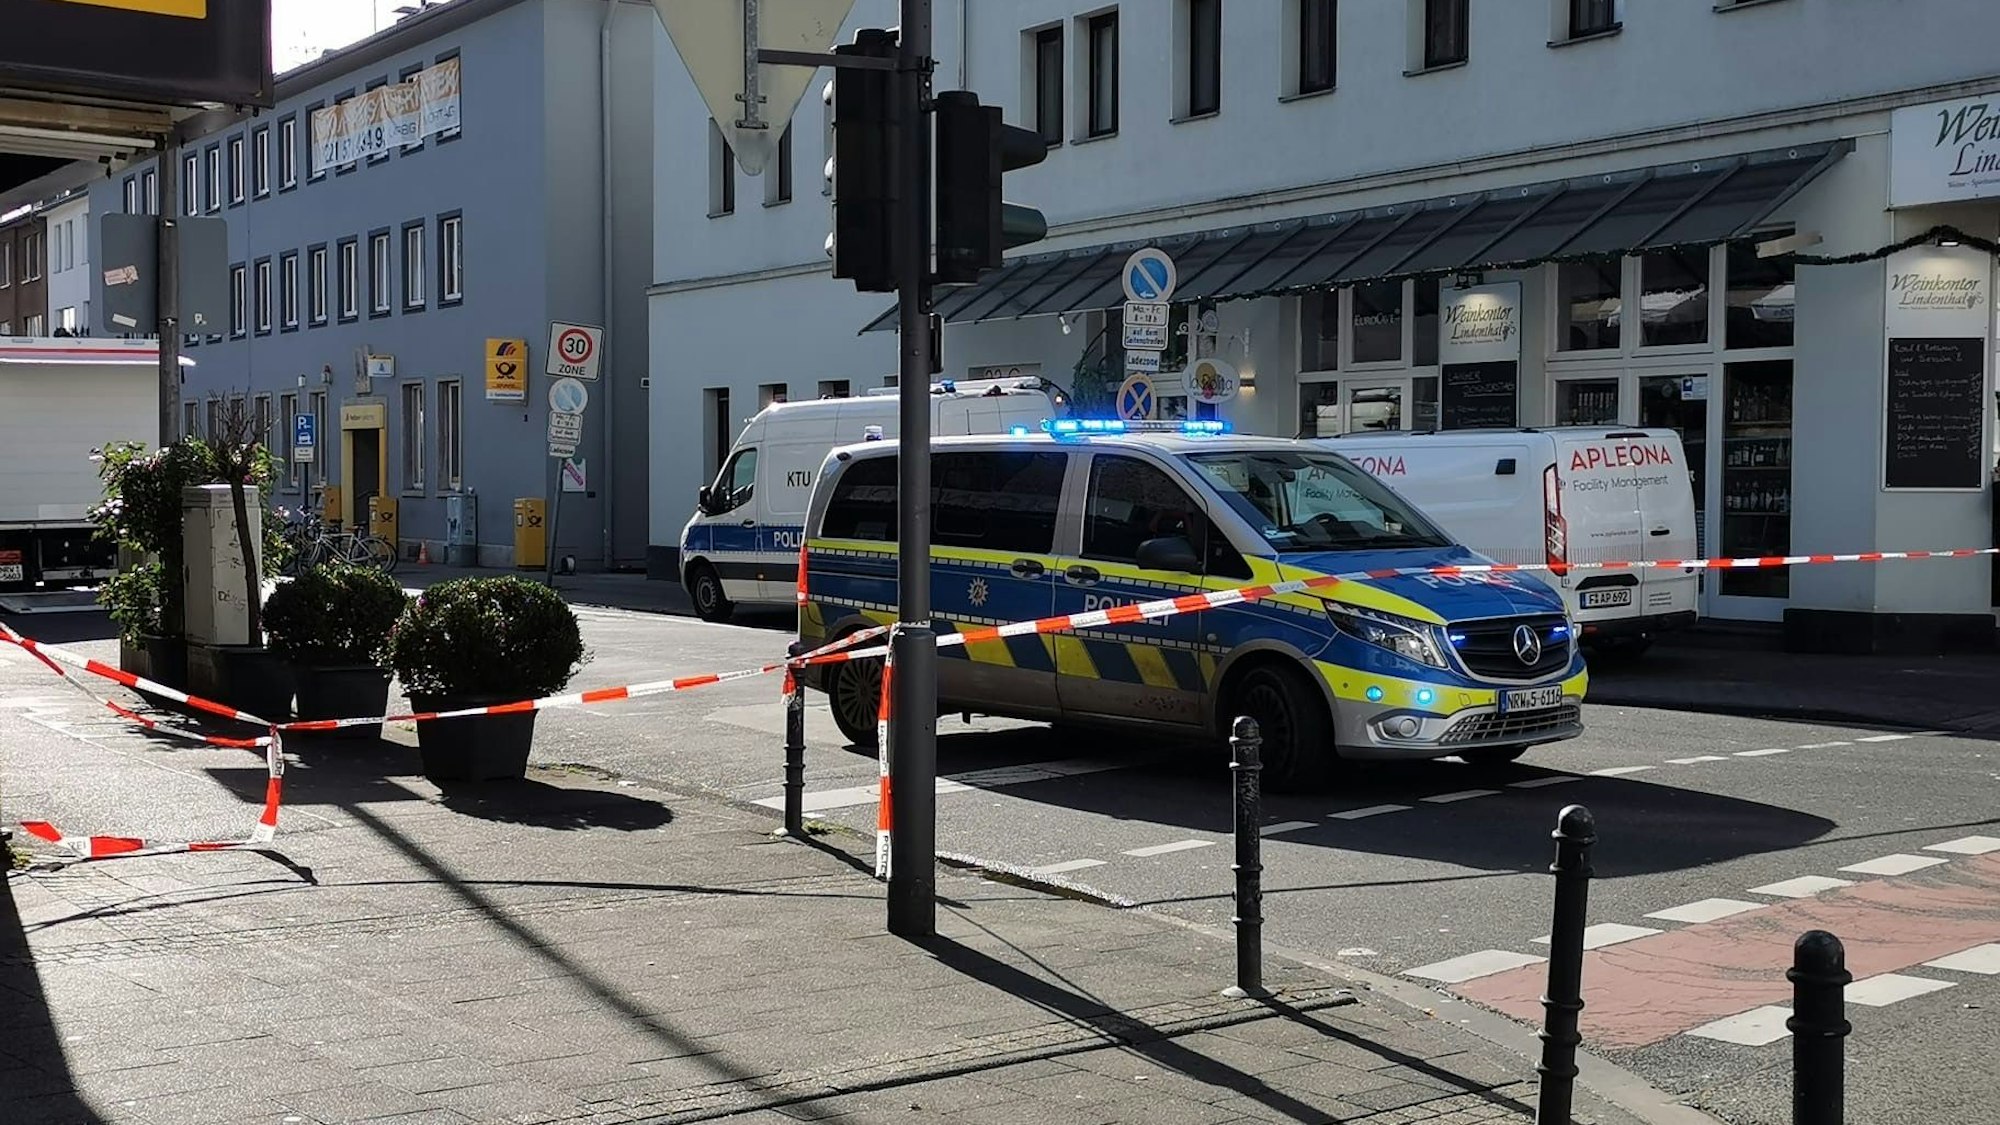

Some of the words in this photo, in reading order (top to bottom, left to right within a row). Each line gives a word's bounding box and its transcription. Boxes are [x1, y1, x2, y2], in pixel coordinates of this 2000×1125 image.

[1935, 103, 2000, 148] Wei
[1891, 273, 1980, 291] Weinkontor
[1898, 290, 1968, 306] Lindenthal
[1445, 303, 1513, 325] Weinkontor
[1450, 321, 1502, 340] Lindenthal
[565, 338, 586, 355] 30
[558, 364, 586, 376] ZONE
[1570, 444, 1673, 471] APLEONA
[787, 471, 811, 487] KTU
[1573, 477, 1609, 492] Facility
[1611, 475, 1669, 490] Management
[773, 531, 804, 548] POLI
[1589, 594, 1595, 604] F
[1601, 592, 1612, 603] AP
[1613, 591, 1628, 602] 692
[1507, 693, 1527, 710] NRW
